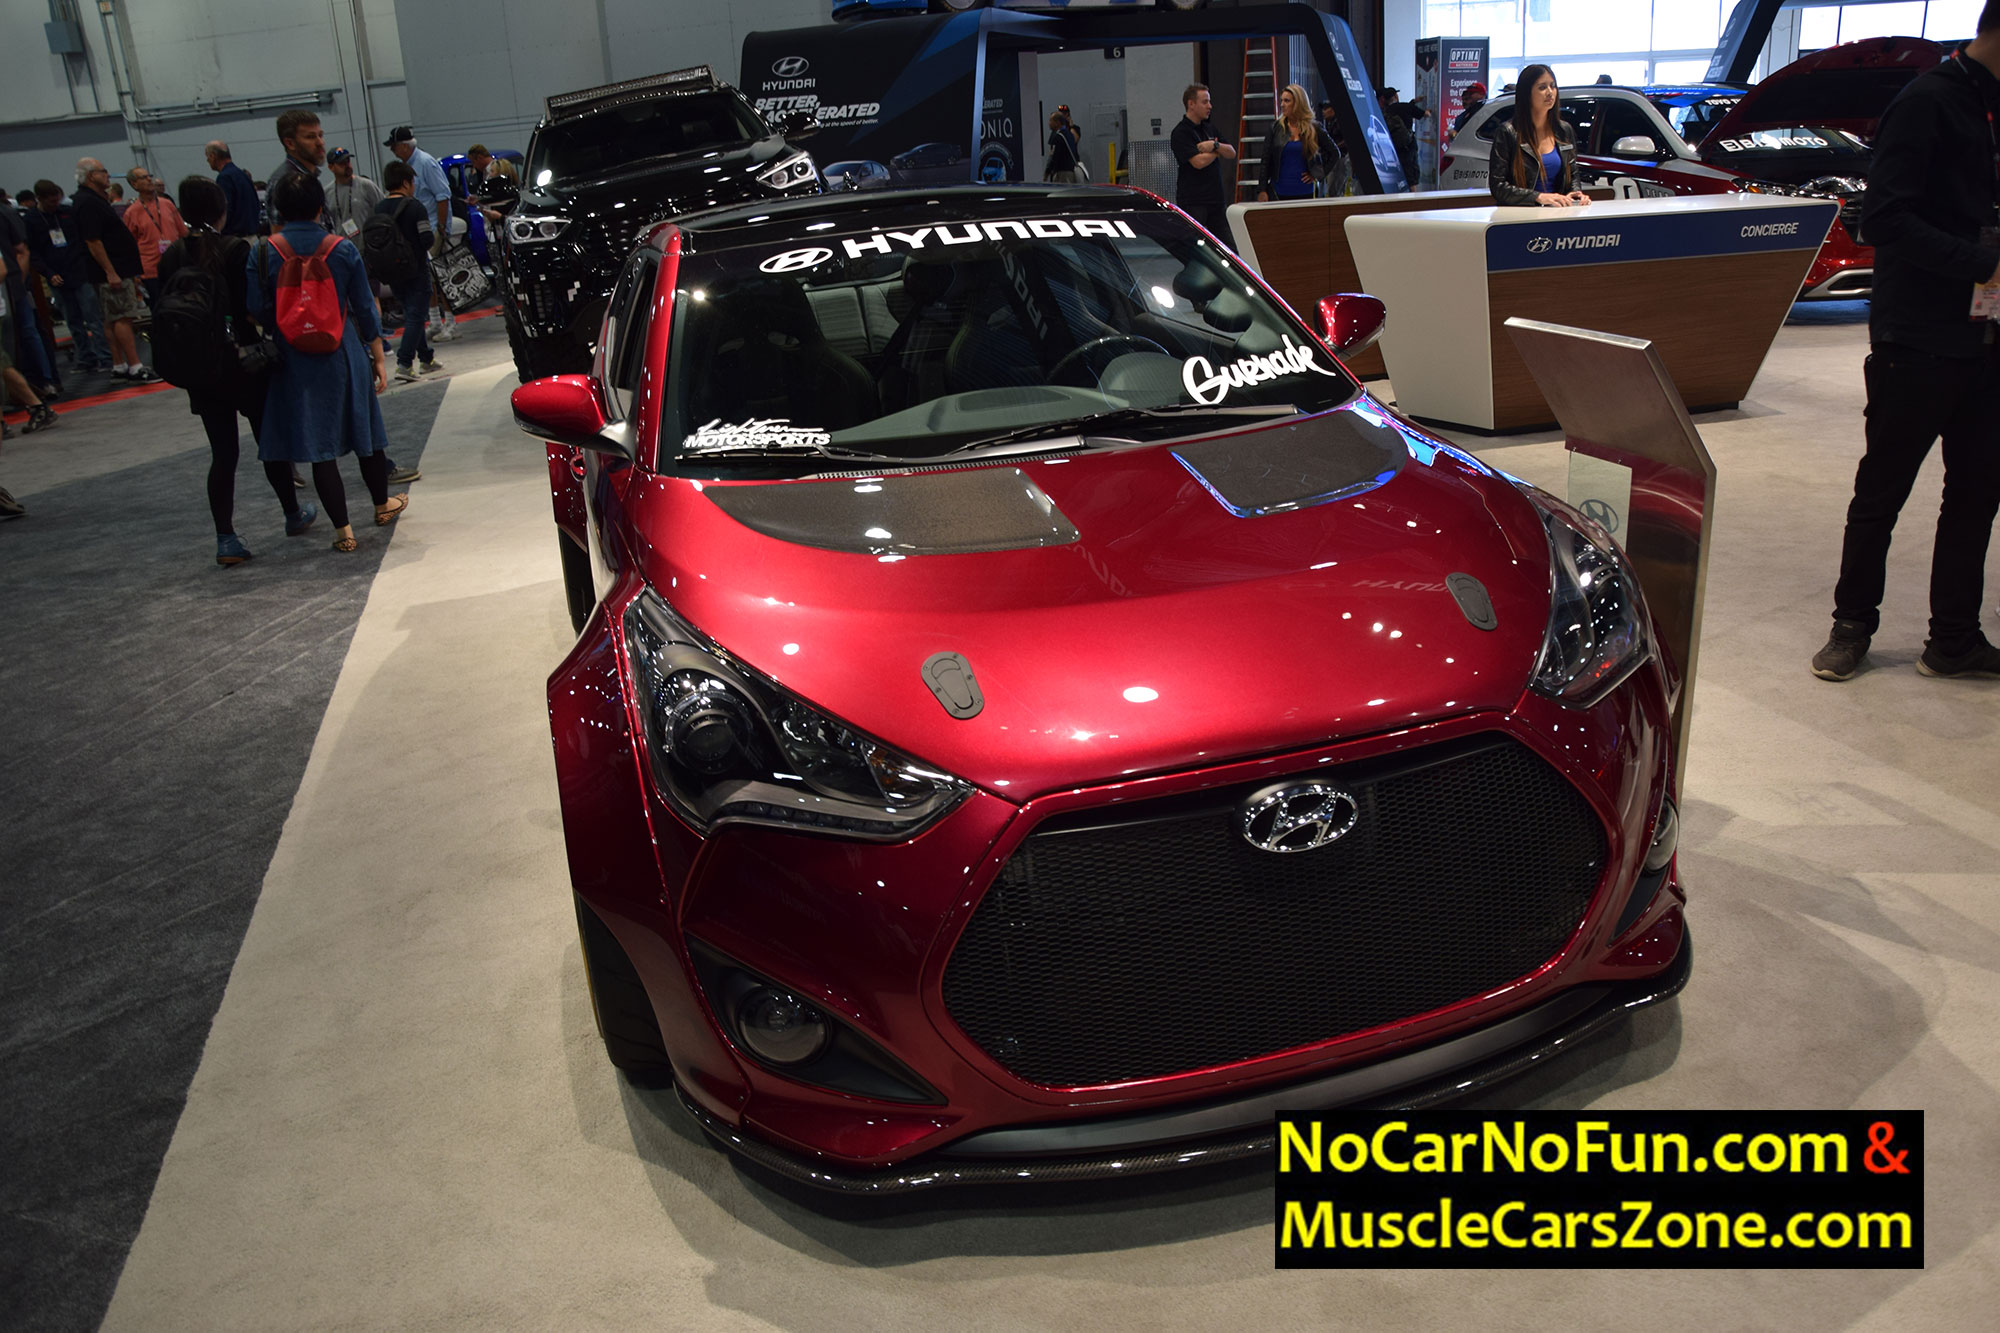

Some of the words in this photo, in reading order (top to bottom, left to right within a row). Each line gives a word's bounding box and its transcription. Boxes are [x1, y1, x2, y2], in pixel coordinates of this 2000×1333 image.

[1113, 46, 1121, 58] 6
[1451, 51, 1479, 61] OPTIMA
[762, 78, 816, 91] HYUNDAI
[755, 95, 821, 110] BETTER,
[1704, 98, 1731, 106] TOYO
[766, 103, 881, 123] ACERATED
[980, 117, 1013, 139] ONIQ
[841, 219, 1136, 259] HYUNDAI
[1555, 234, 1621, 251] HYUNDAI
[1740, 222, 1800, 238] CONCIERGE
[683, 432, 831, 448] MOTORSPORTS
